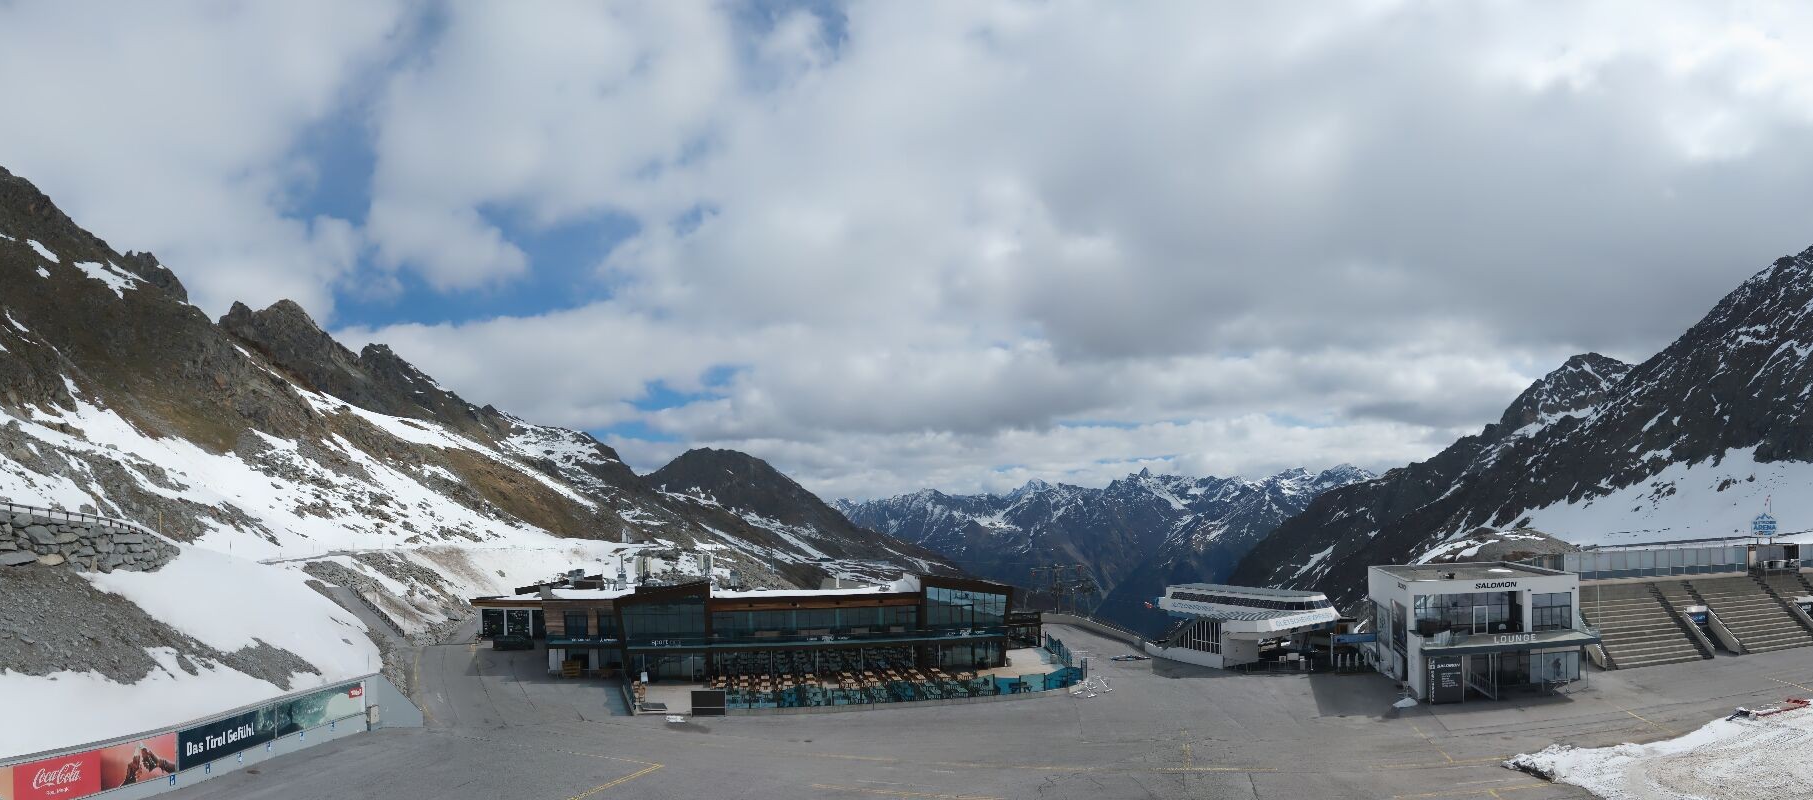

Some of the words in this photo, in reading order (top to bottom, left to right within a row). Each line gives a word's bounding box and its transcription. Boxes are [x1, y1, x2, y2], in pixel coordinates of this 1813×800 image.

[1494, 634, 1536, 644] LOUNGE
[187, 742, 203, 756] Das
[206, 732, 226, 750] Tirol
[228, 722, 255, 743] Gefühl
